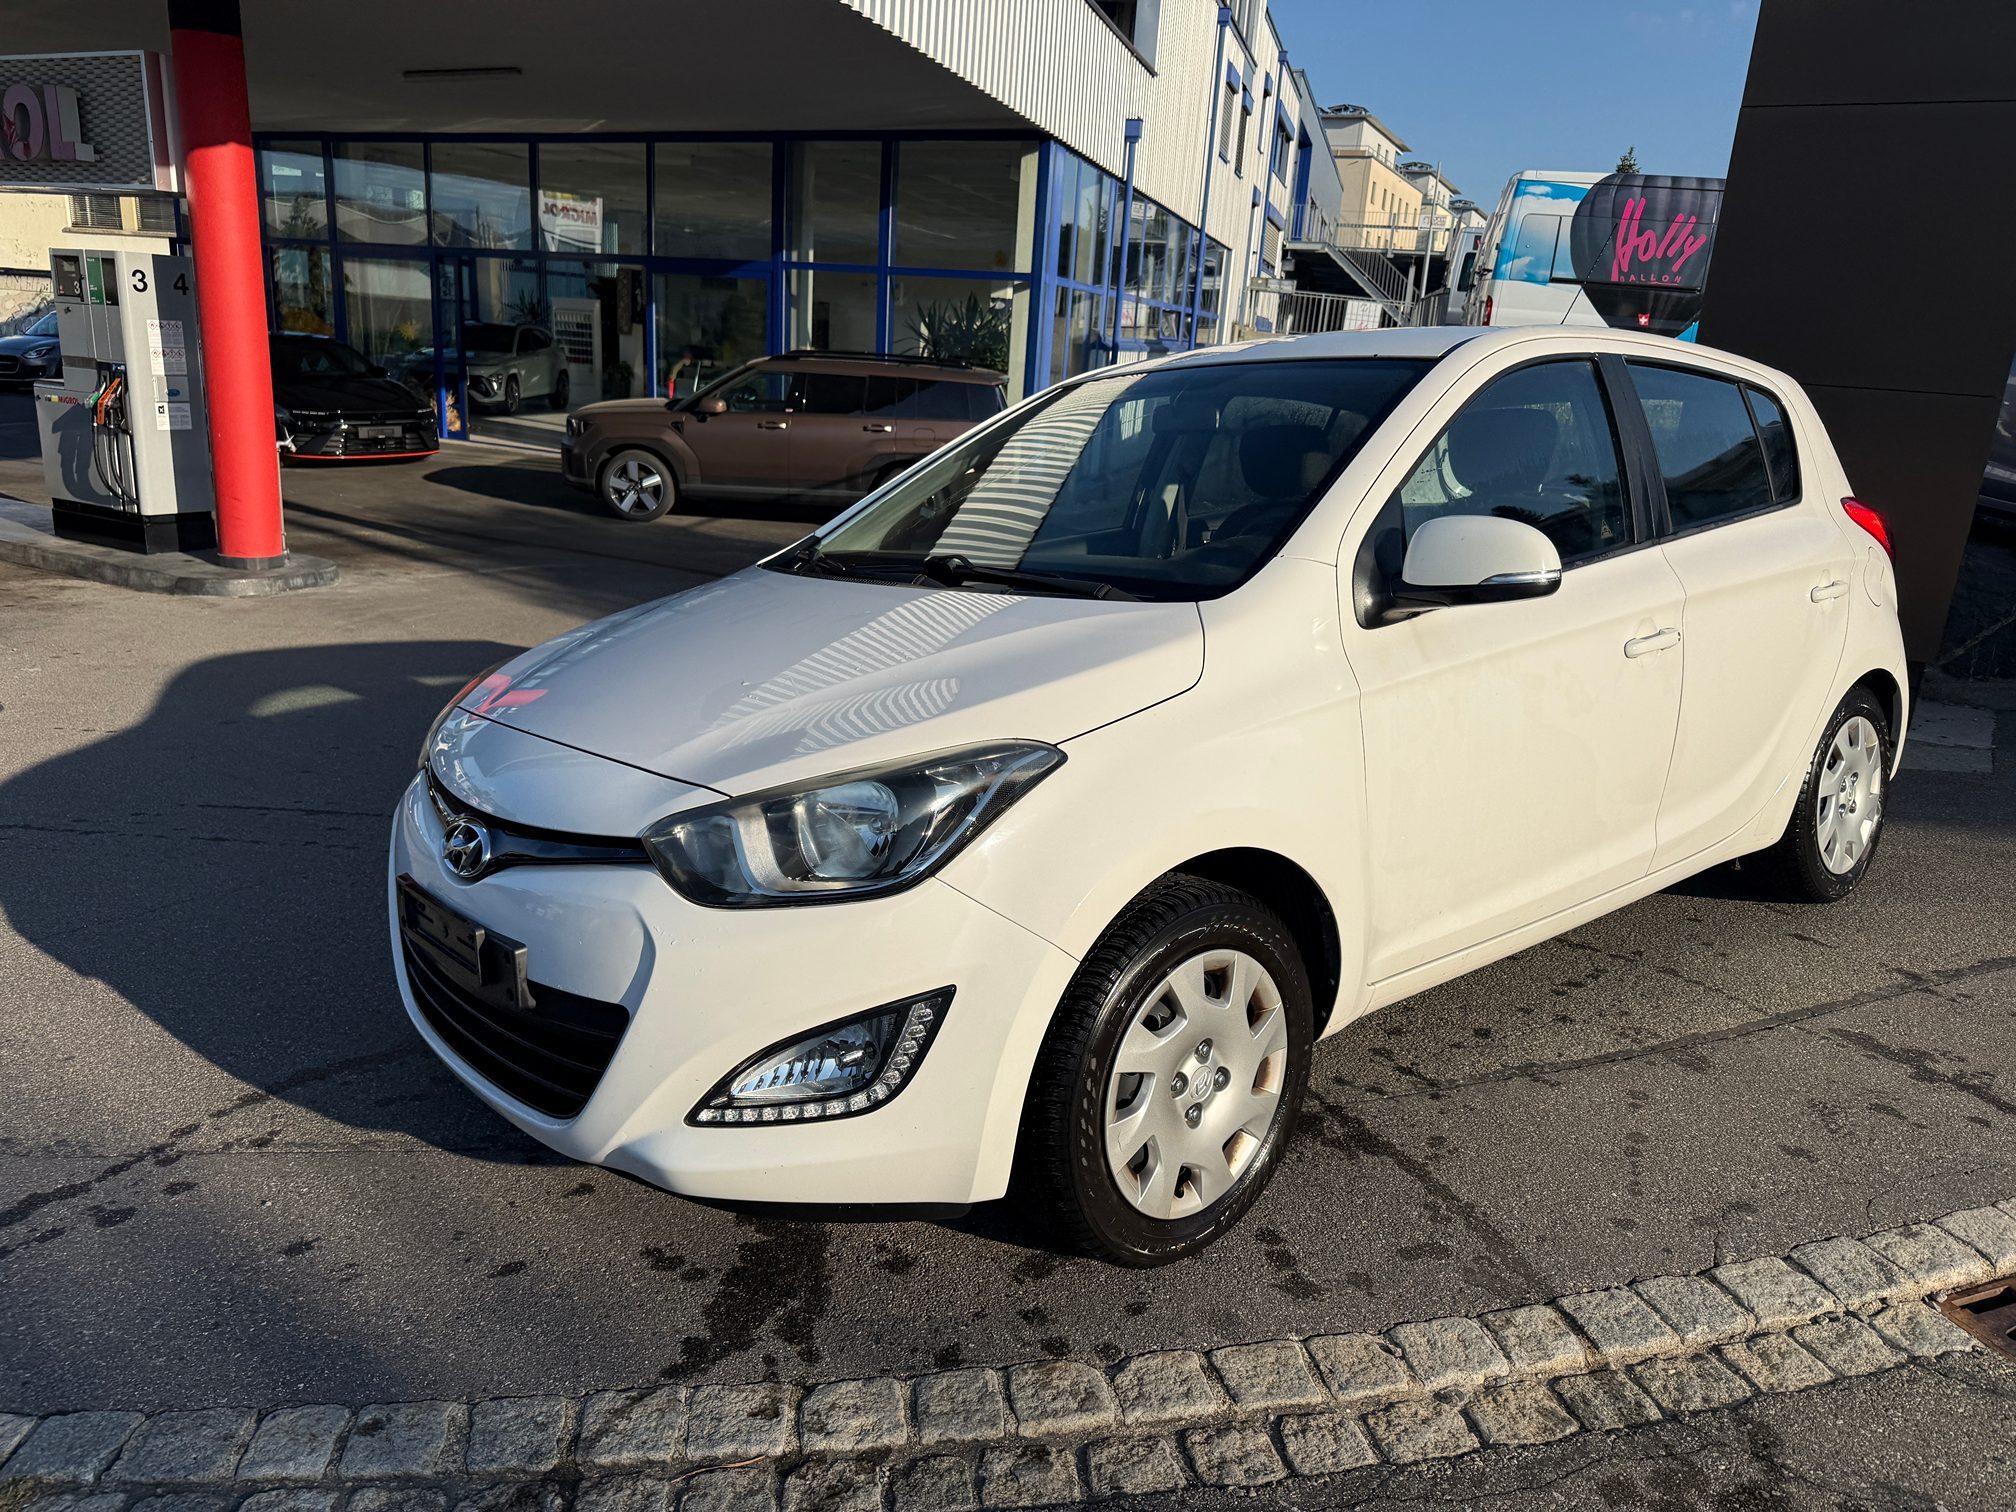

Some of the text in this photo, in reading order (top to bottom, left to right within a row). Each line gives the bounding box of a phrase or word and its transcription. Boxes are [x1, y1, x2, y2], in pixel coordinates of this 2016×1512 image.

[0, 83, 88, 162] OL
[1611, 197, 1707, 281] Holly
[73, 281, 80, 294] 3
[131, 269, 148, 293] 3
[173, 273, 189, 295] 4
